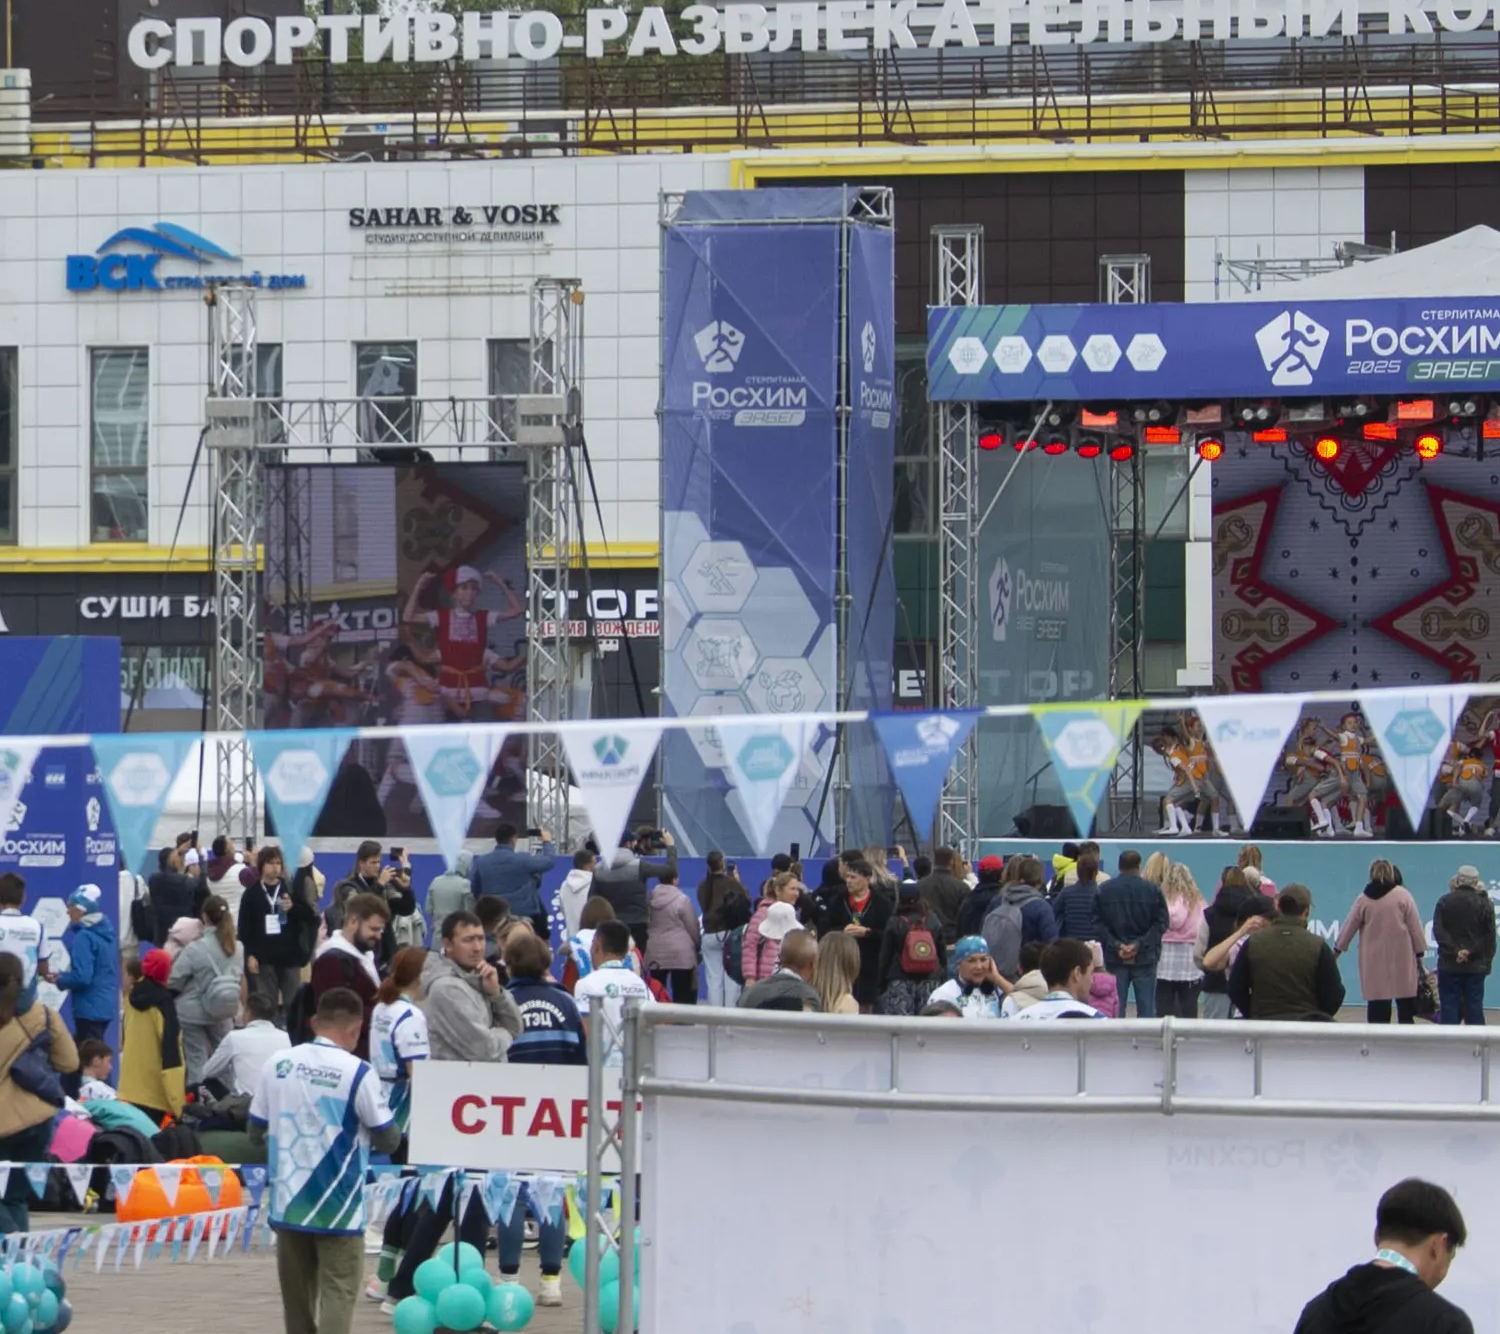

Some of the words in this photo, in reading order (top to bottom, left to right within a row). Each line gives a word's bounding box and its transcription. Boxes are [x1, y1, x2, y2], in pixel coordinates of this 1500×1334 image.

[349, 206, 444, 227] SAHAR
[452, 205, 473, 226] &
[482, 203, 560, 225] VOSK
[65, 253, 162, 291] ВСК
[1347, 359, 1401, 374] 2025
[79, 595, 171, 619] СУШИ
[523, 1012, 553, 1028] ТЭЦ
